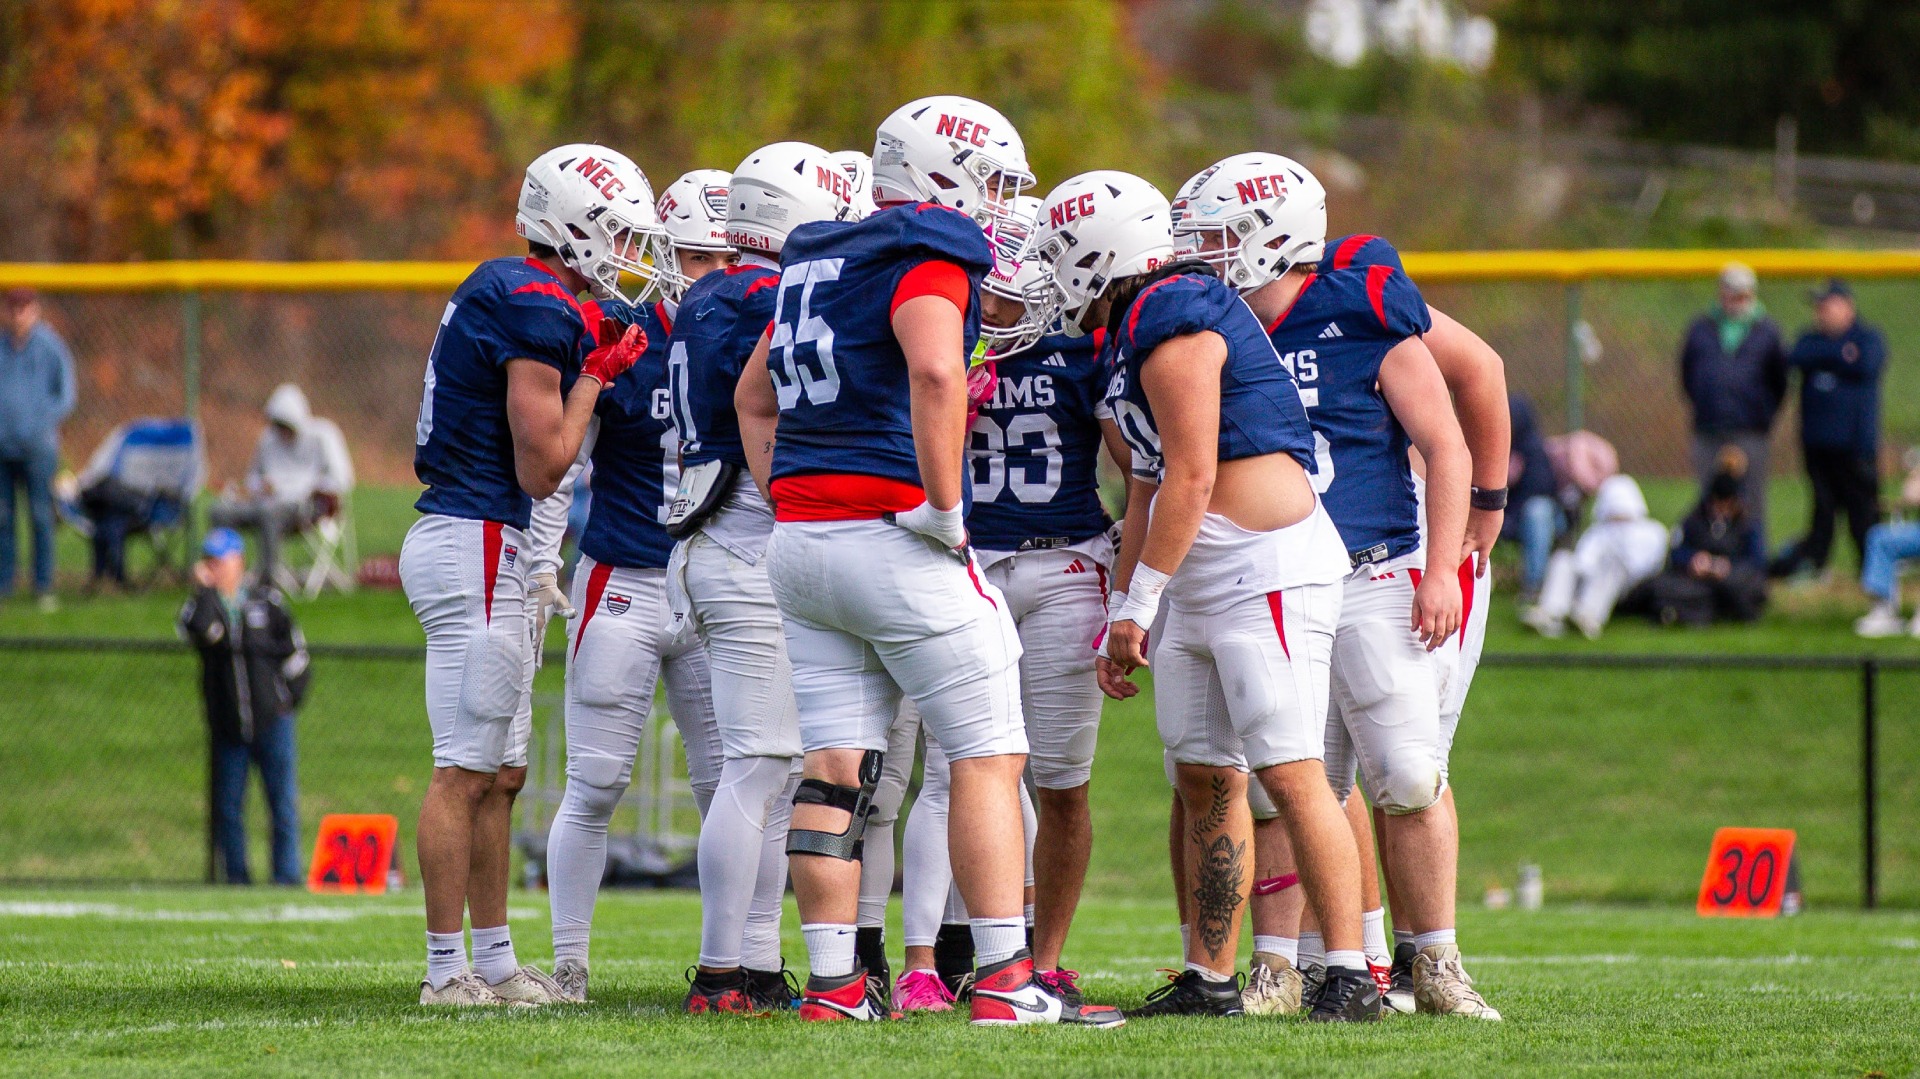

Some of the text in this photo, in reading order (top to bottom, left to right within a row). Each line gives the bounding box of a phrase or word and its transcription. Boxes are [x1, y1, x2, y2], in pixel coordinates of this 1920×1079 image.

[936, 113, 991, 148] NEC
[575, 156, 626, 201] NEC
[816, 165, 851, 204] NEC
[1235, 174, 1289, 205] NEC
[655, 191, 678, 223] EC
[1050, 192, 1095, 231] NEC
[770, 257, 845, 410] 55
[651, 388, 671, 420] G
[982, 374, 1056, 409] IMS
[965, 413, 1063, 503] 83
[1713, 848, 1775, 907] 30
